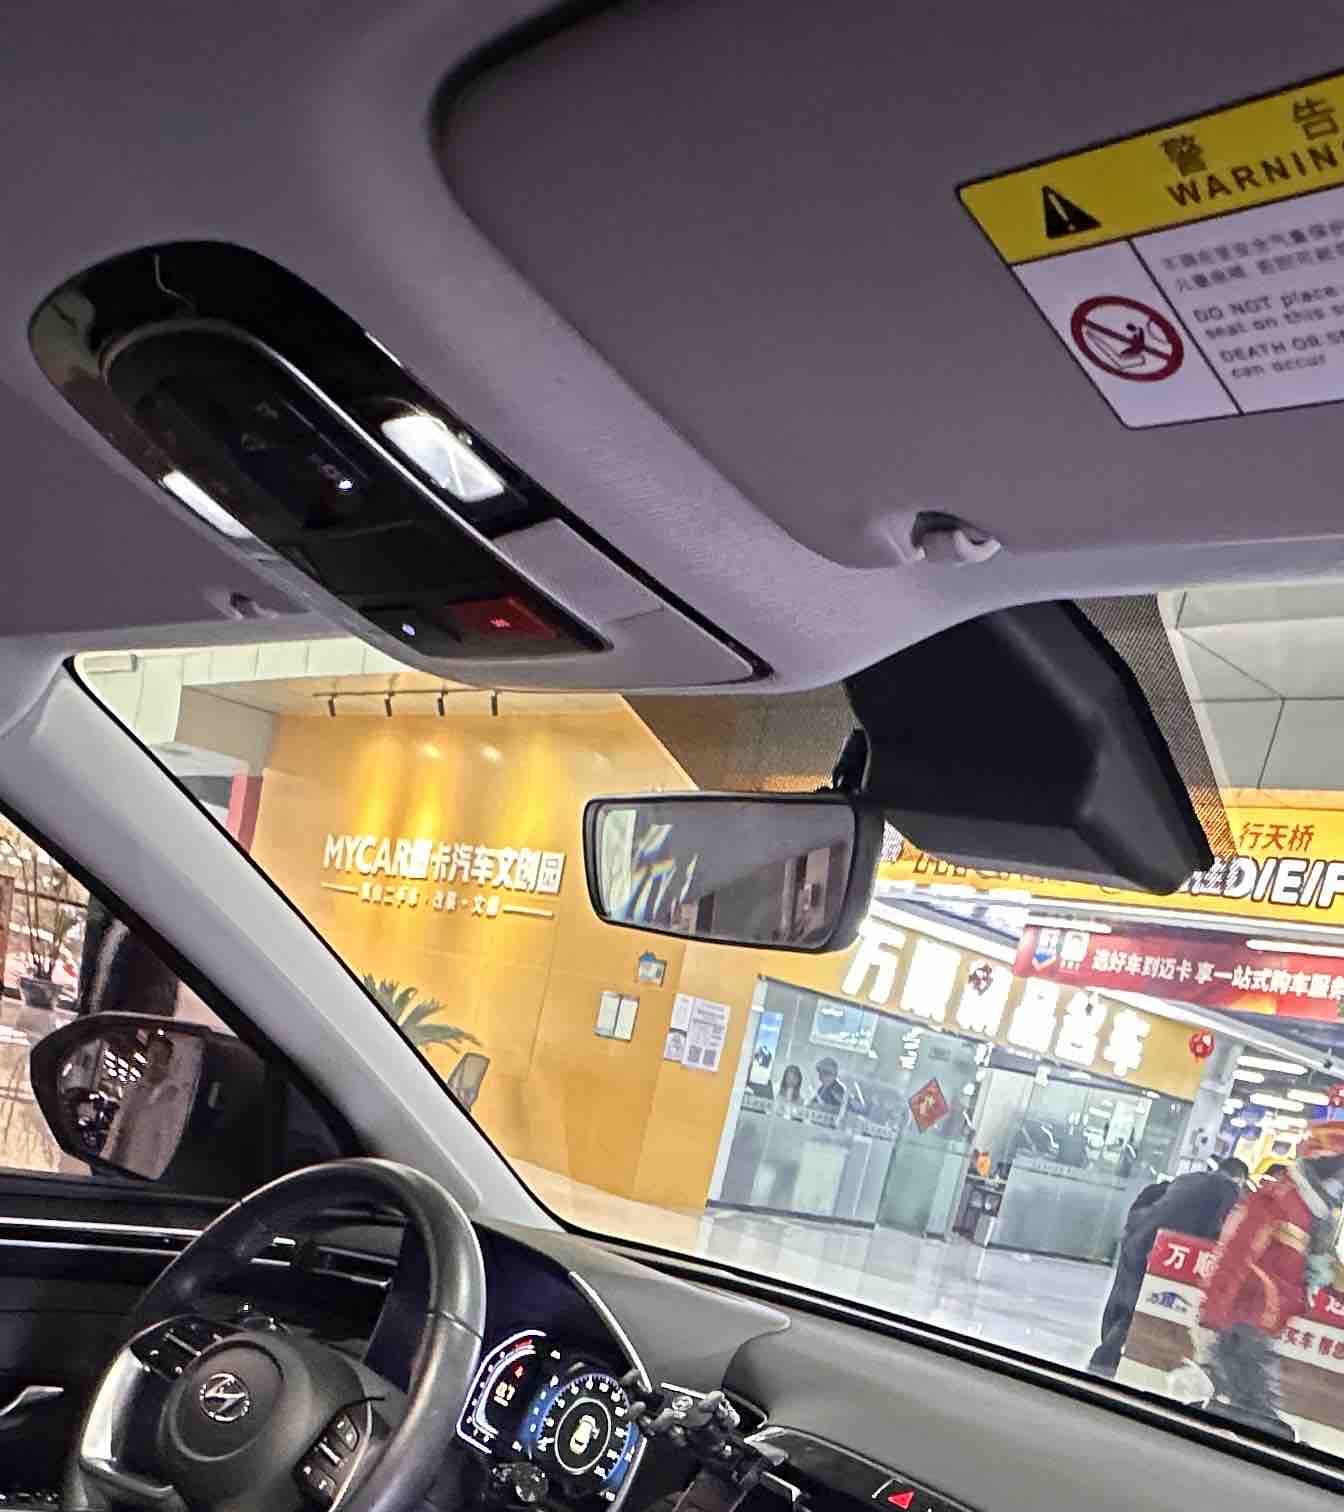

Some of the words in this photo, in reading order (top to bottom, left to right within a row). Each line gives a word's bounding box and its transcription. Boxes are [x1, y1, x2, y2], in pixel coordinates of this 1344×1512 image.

[1161, 97, 1340, 178] 警告
[1193, 308, 1223, 323] DO
[1229, 295, 1270, 314] NOT
[1281, 283, 1335, 309] place
[1205, 319, 1248, 340] seat
[1252, 314, 1278, 331] on
[1283, 303, 1325, 325] this
[1219, 340, 1286, 364] DEATH
[1292, 332, 1321, 351] OR
[1231, 363, 1265, 379] can
[1271, 353, 1327, 373] occur
[1239, 822, 1315, 852] 行天桥
[323, 834, 566, 895] MYCAR卡汽车文创园
[841, 918, 1152, 1078] 万品名车
